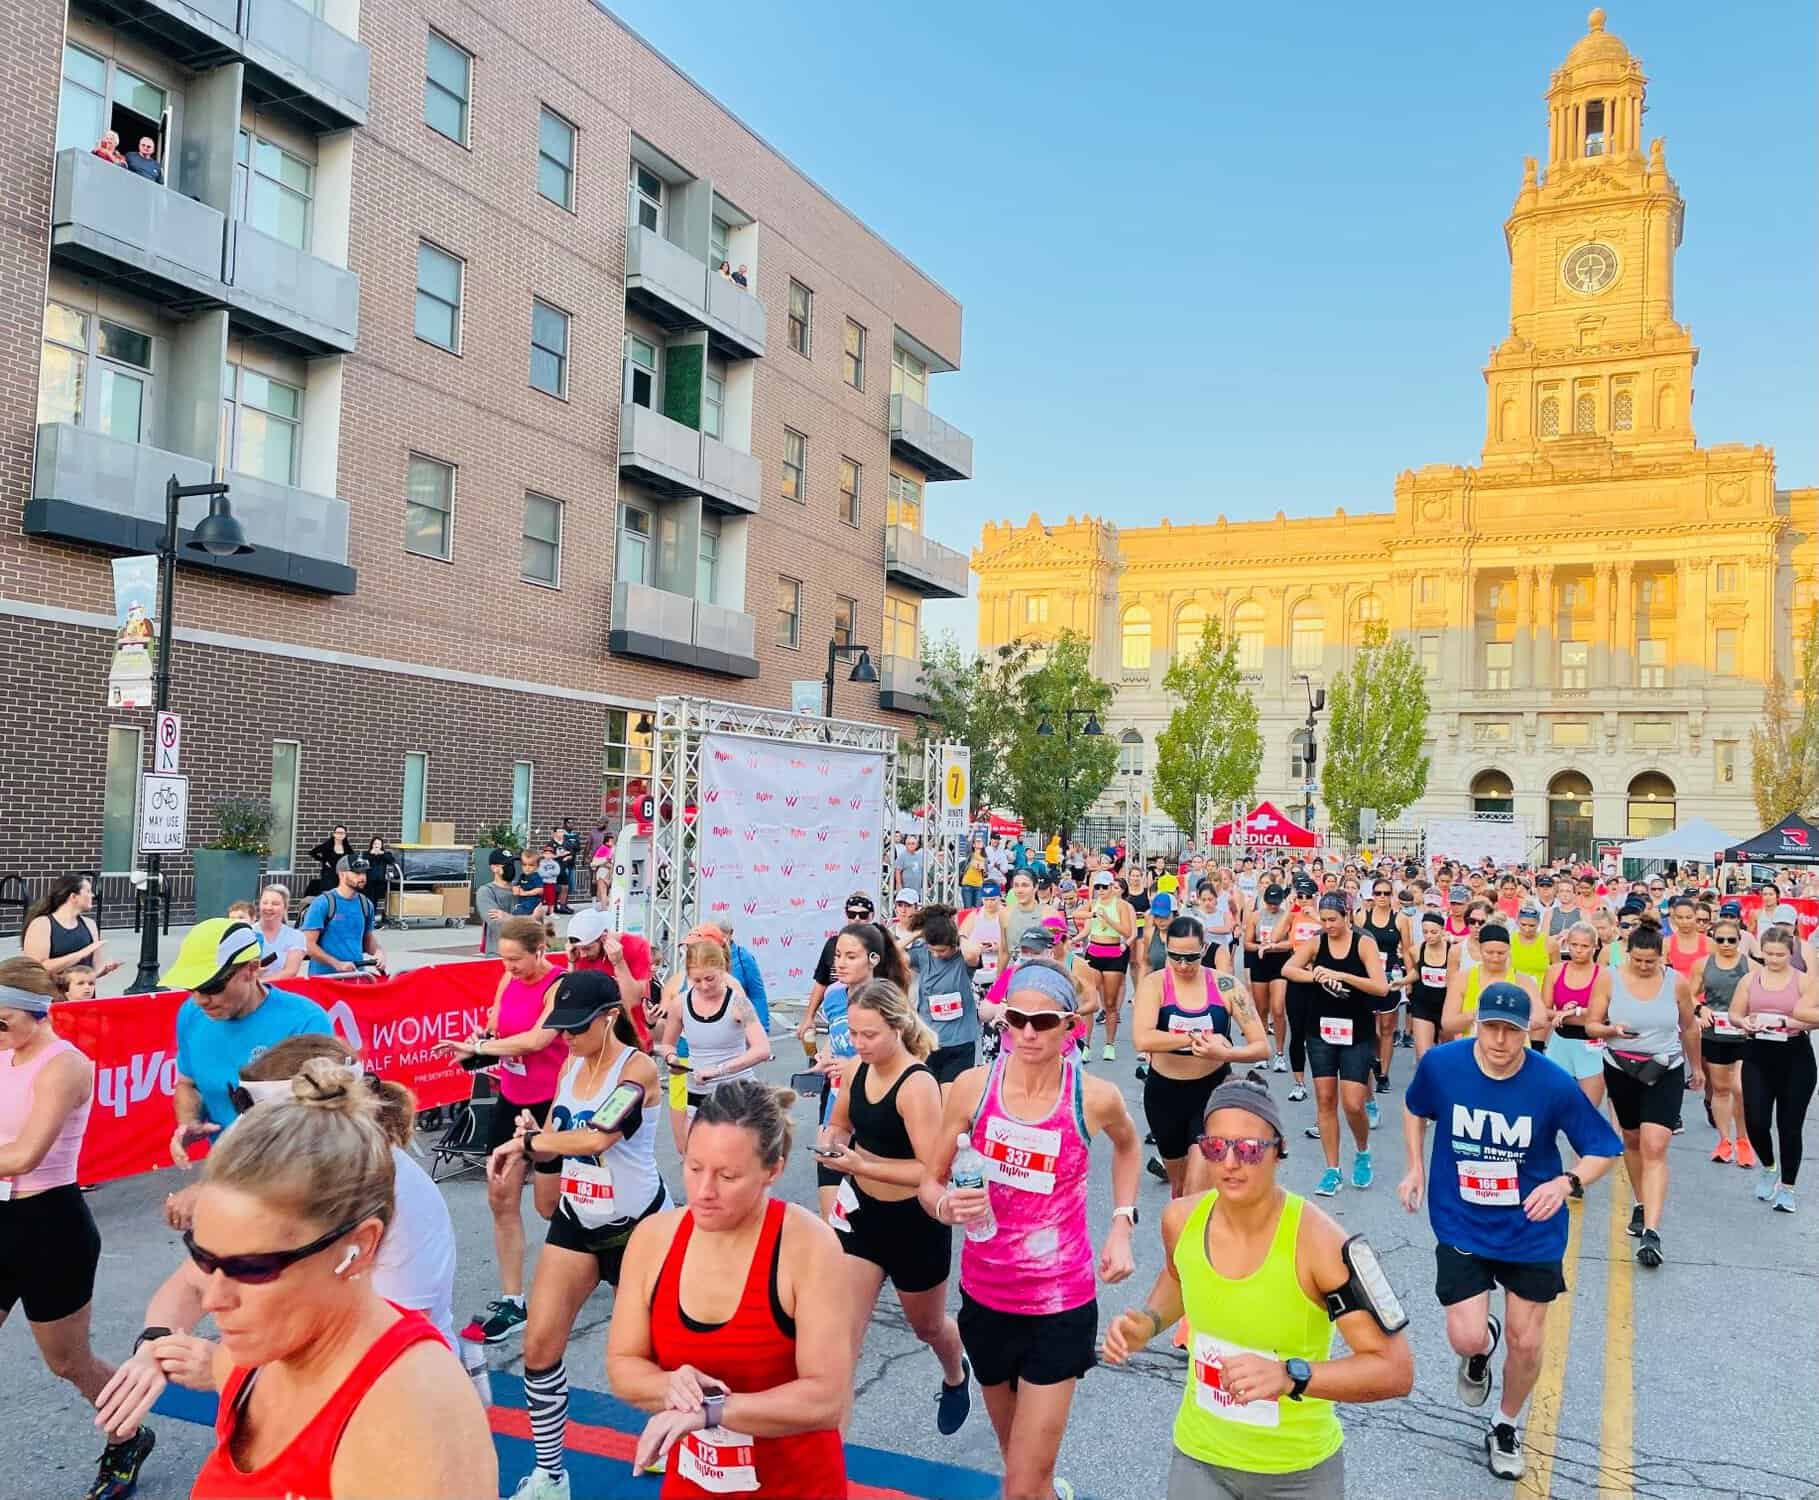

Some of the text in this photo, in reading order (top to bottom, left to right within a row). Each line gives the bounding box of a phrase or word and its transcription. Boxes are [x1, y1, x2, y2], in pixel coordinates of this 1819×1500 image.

[951, 772, 960, 800] 7
[149, 815, 180, 828] MAY USE
[144, 832, 182, 845] FULL LANE
[1006, 1148, 1032, 1167] 337
[697, 1442, 719, 1465] 173
